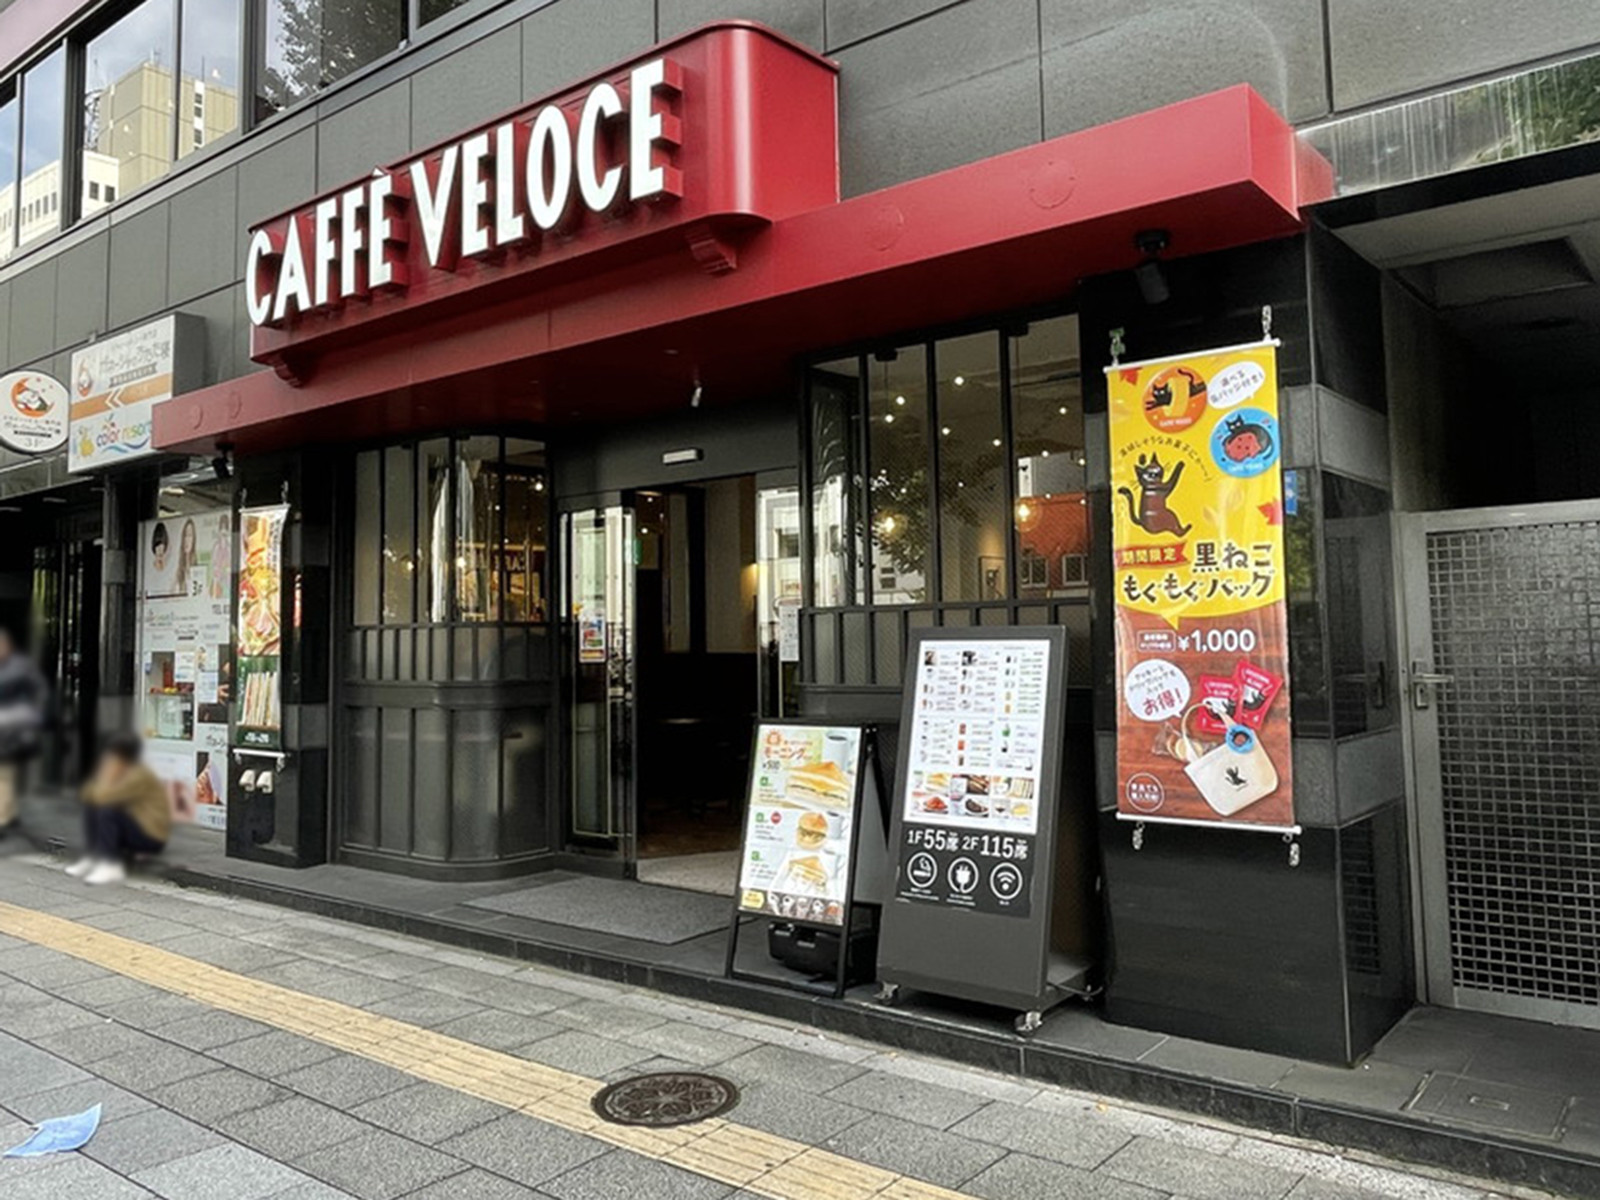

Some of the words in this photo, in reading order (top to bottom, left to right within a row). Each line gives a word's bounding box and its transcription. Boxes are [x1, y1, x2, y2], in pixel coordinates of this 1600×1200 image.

[246, 167, 393, 327] CAFFÈ
[410, 58, 665, 268] VELOCE
[1121, 546, 1177, 565] 期間限定
[1192, 541, 1273, 573] 黒ねこ
[1123, 570, 1274, 603] もぐもぐバッグ
[1177, 628, 1256, 654] ¥1,000
